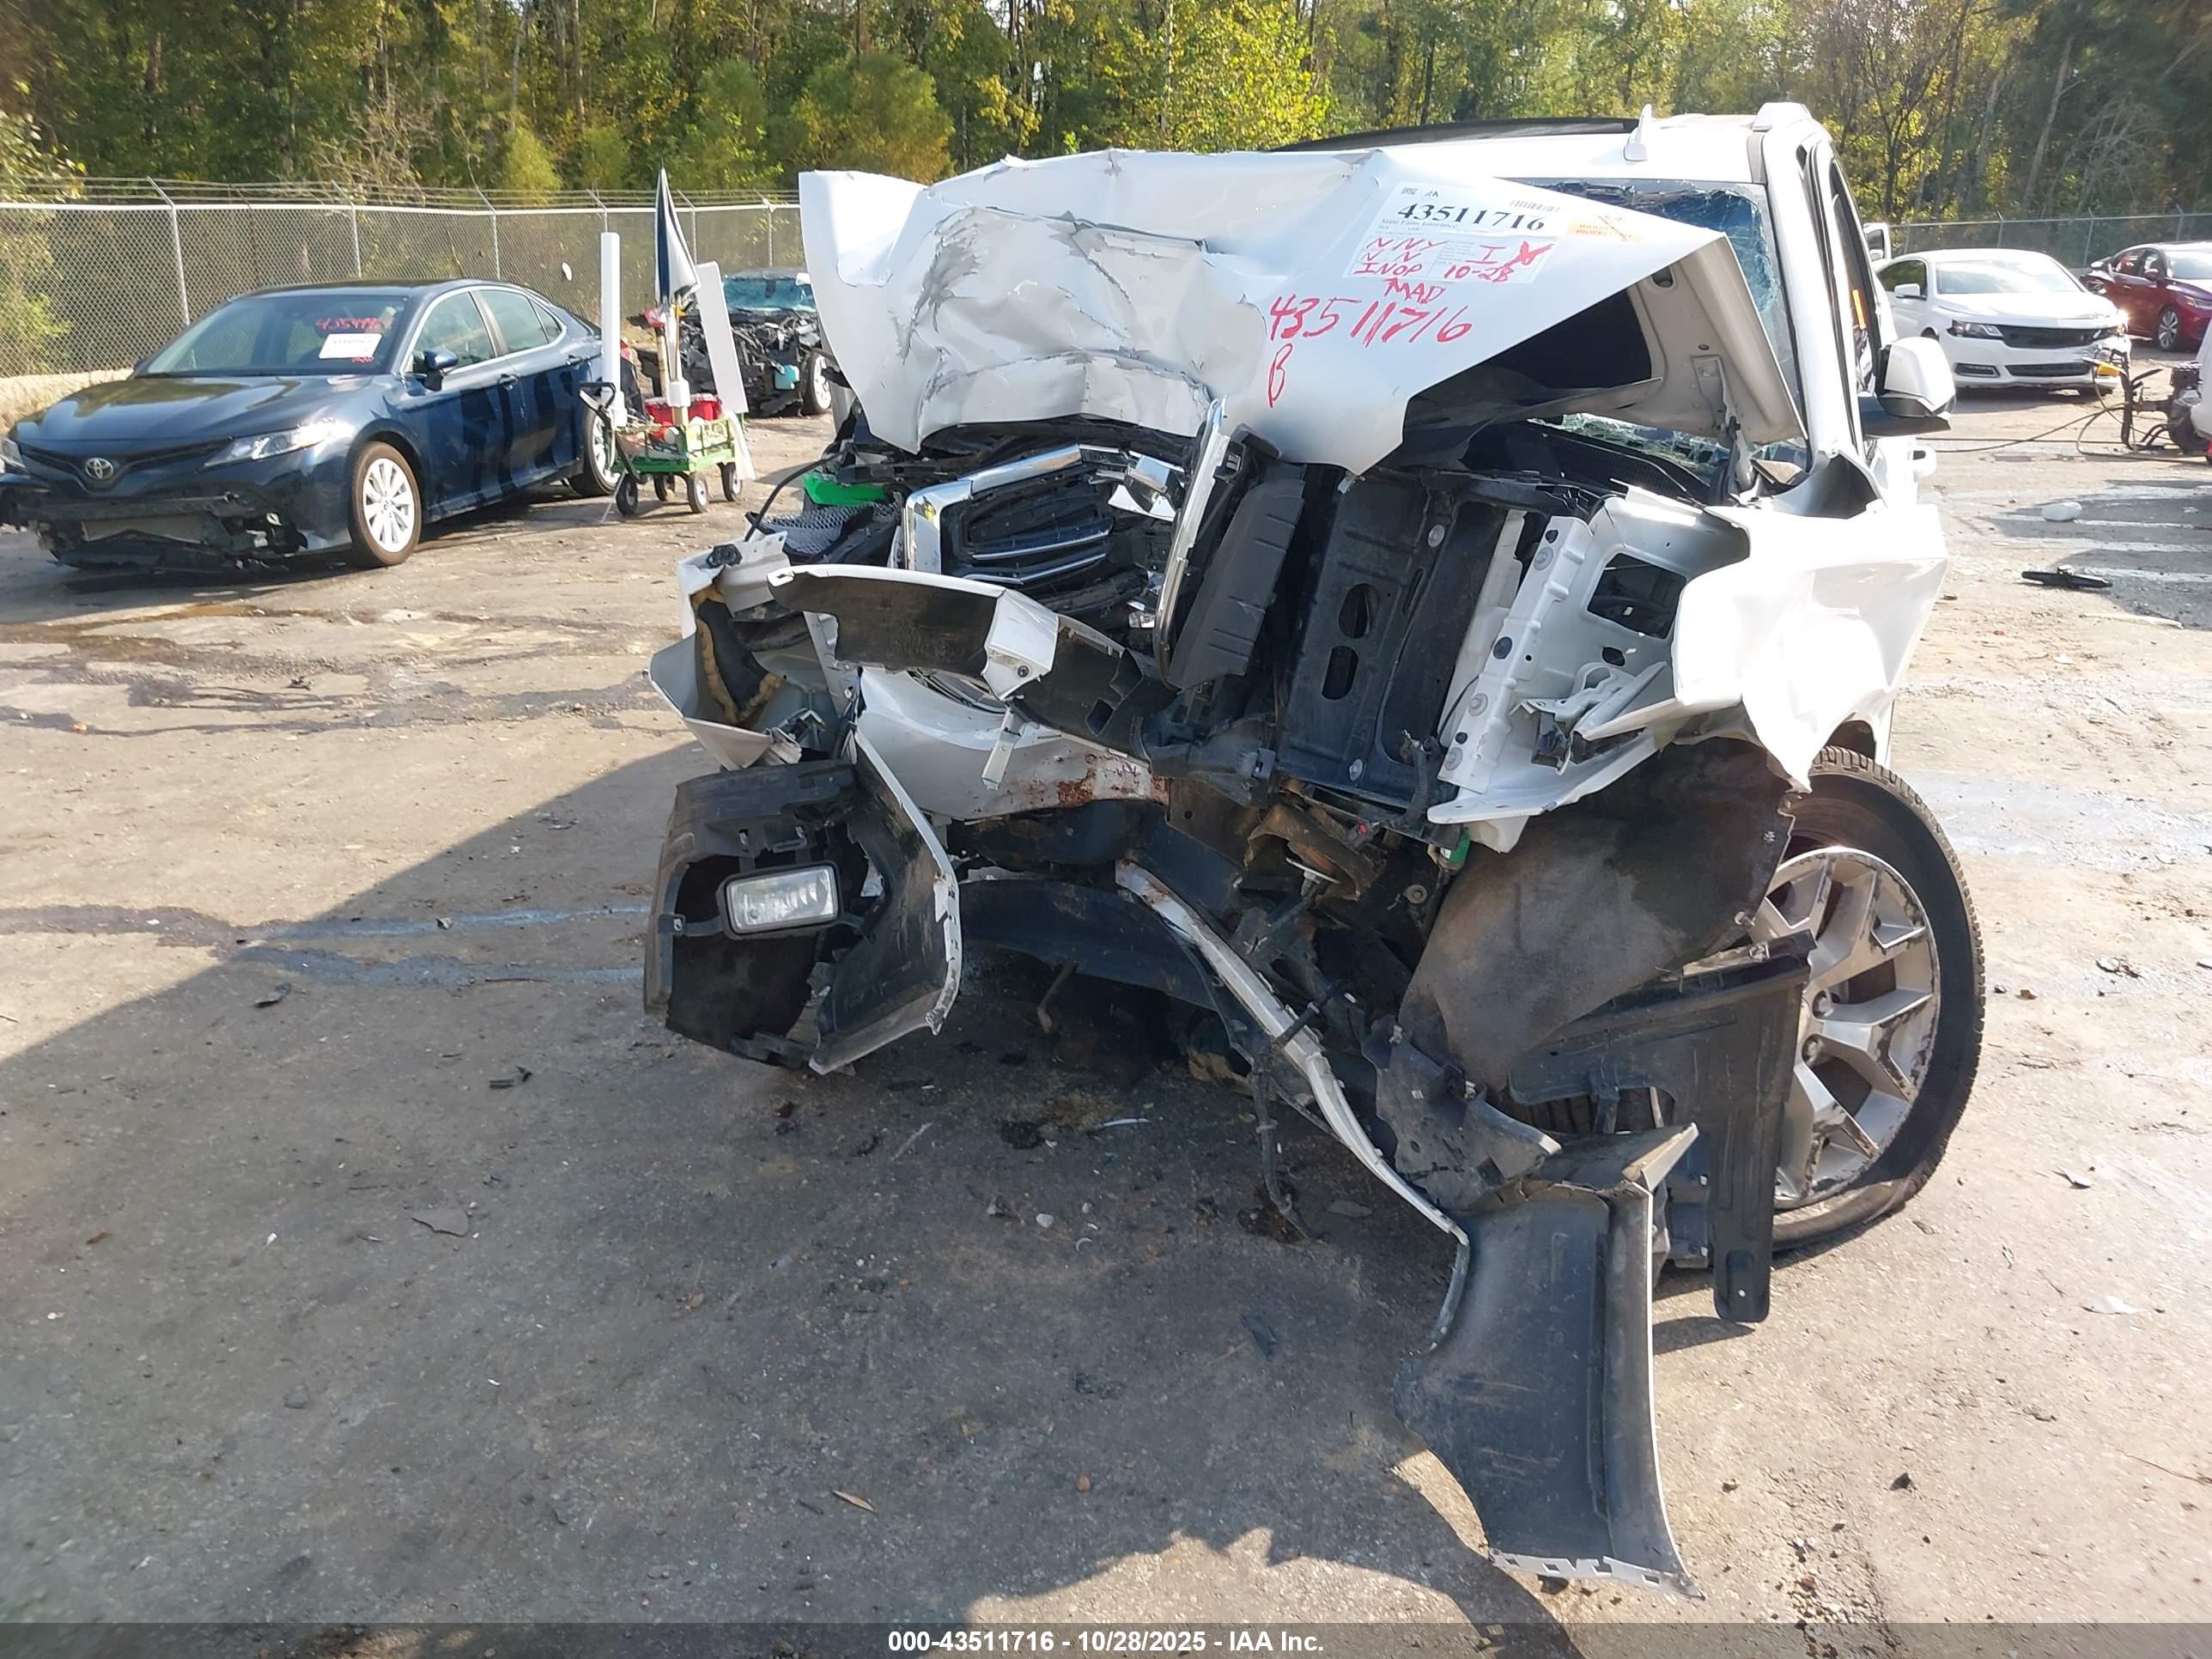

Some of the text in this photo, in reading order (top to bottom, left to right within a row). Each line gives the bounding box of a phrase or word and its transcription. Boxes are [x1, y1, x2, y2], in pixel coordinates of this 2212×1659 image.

[1397, 203, 1547, 230] 43511716
[1353, 262, 1423, 276] INOP
[1384, 277, 1447, 304] MAD
[1270, 294, 1473, 349] 43511716
